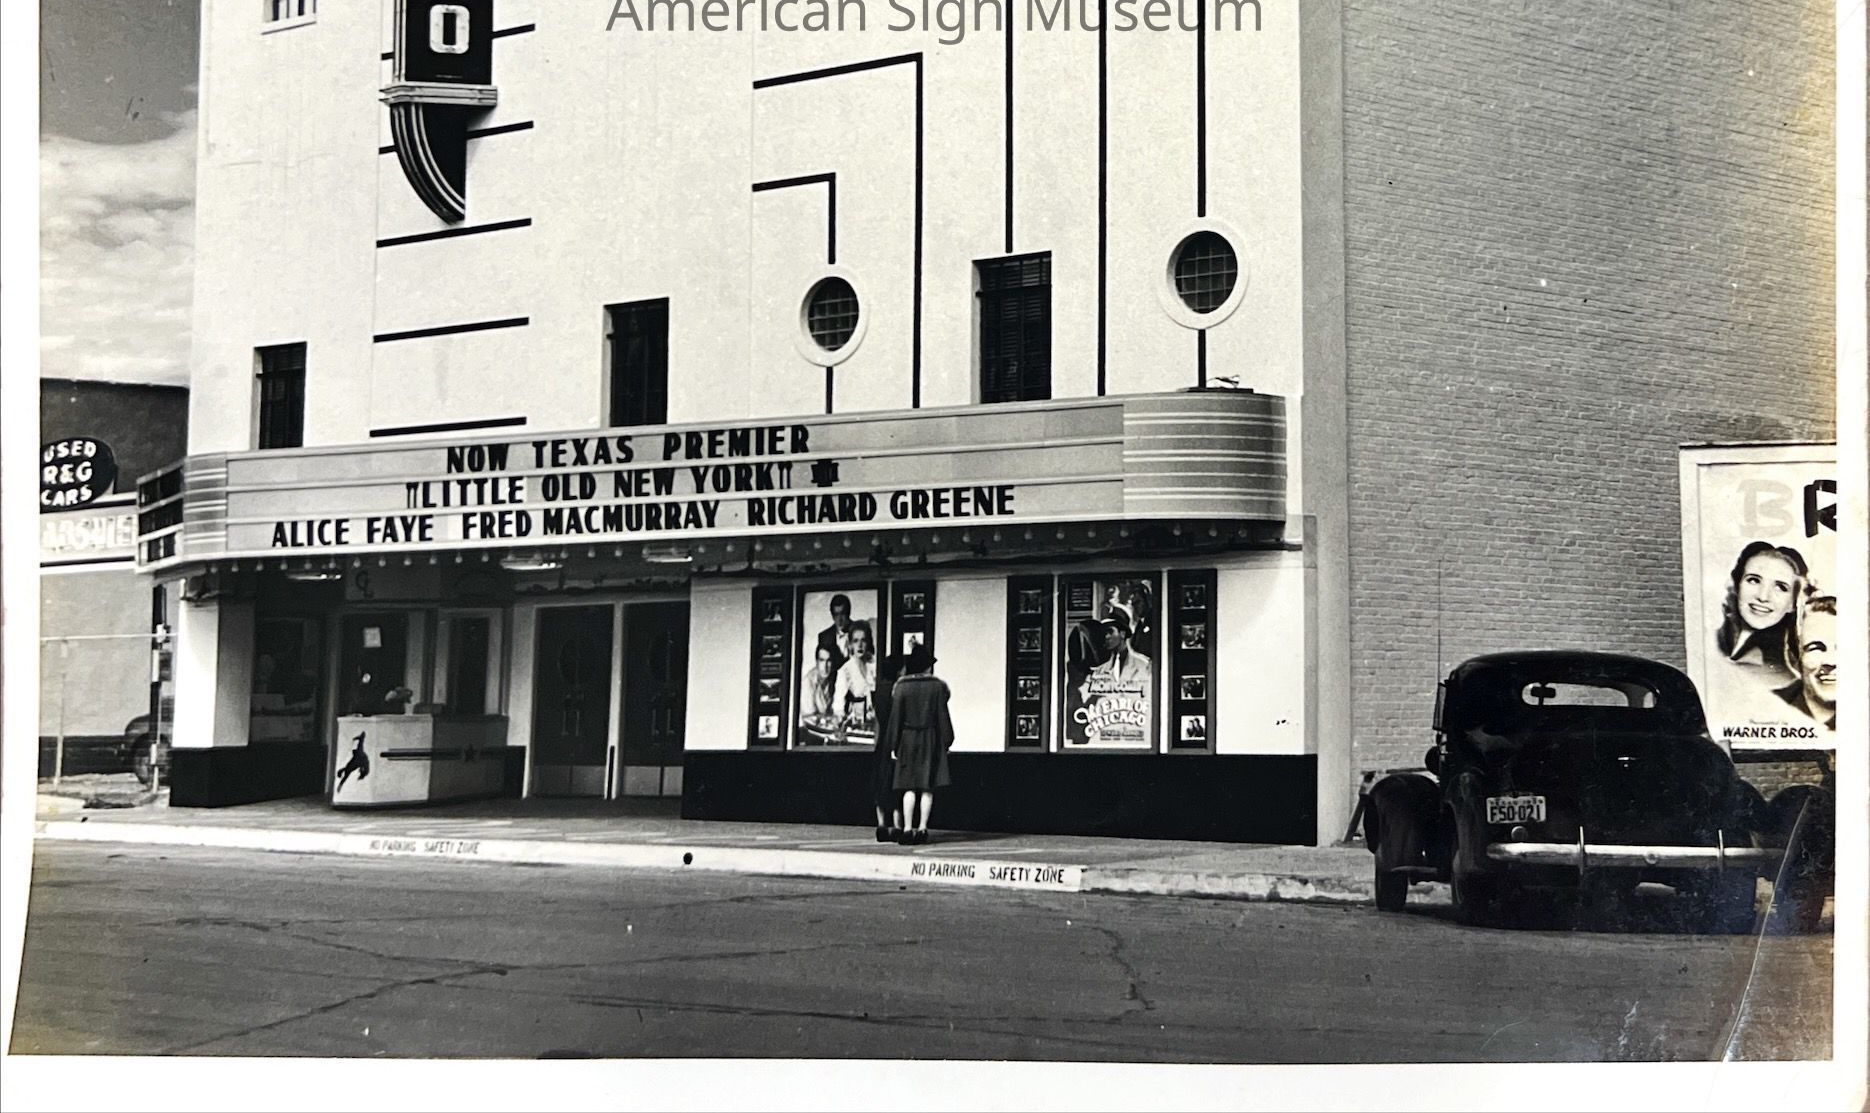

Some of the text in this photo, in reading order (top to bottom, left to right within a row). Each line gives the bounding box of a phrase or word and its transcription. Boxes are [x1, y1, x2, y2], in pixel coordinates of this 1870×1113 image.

[43, 440, 97, 463] USED
[447, 424, 810, 474] NOW TEXAS PREMIER
[40, 484, 93, 507] CARS
[541, 472, 597, 502] OLD
[613, 468, 676, 498] NEW
[272, 485, 1015, 548] ALICE FAYE FRED MACMURRAY RICHARD GREENE
[1084, 710, 1146, 738] CHICAGO
[1722, 726, 1818, 739] WARNER BROS.
[424, 840, 455, 853] SAFETY
[911, 862, 1065, 884] NO PARKING SAFETY ZONE
